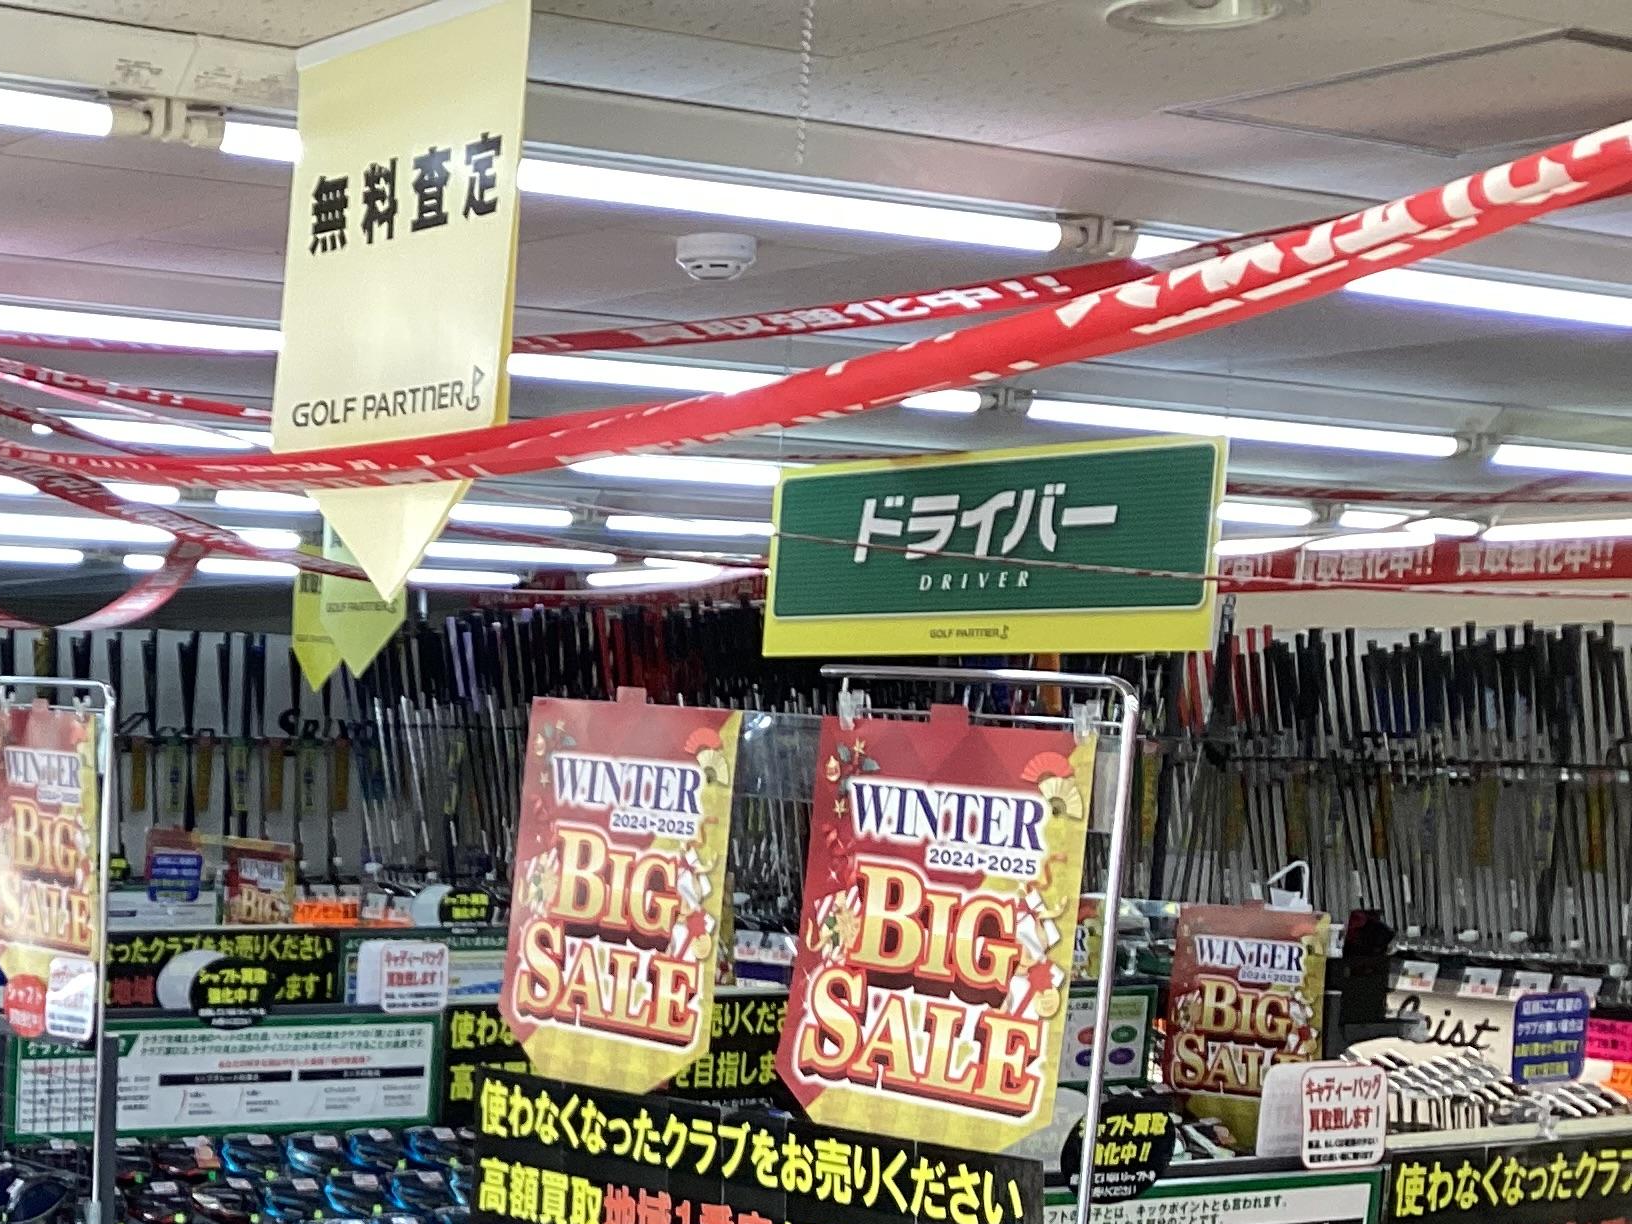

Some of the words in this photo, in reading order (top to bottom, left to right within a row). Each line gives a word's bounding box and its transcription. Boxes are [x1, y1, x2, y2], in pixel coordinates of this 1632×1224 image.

[308, 131, 503, 255] 無料査定
[622, 275, 1070, 343] 買取強化中!!
[292, 395, 357, 429] GOLF
[361, 379, 464, 421] PARTNER
[853, 482, 1118, 564] ドライバー
[919, 570, 1031, 592] DRIVER
[1457, 540, 1616, 577] 買取強化中!!
[3, 747, 81, 788] WINTER
[551, 753, 703, 815] WINTER
[11, 797, 78, 873] BIG
[850, 780, 1046, 852] WINTER
[556, 826, 683, 939] BIG
[849, 862, 1022, 992] BIG
[1195, 936, 1305, 973] WINTER
[518, 918, 701, 1046] SALE
[1200, 976, 1293, 1039] BIG
[801, 967, 1048, 1108] SALE
[1171, 1031, 1323, 1099] SAL
[1305, 1073, 1382, 1104] キャディーバッグ
[1048, 1194, 1287, 1224] フト子とは、キックポイントとも言われます。
